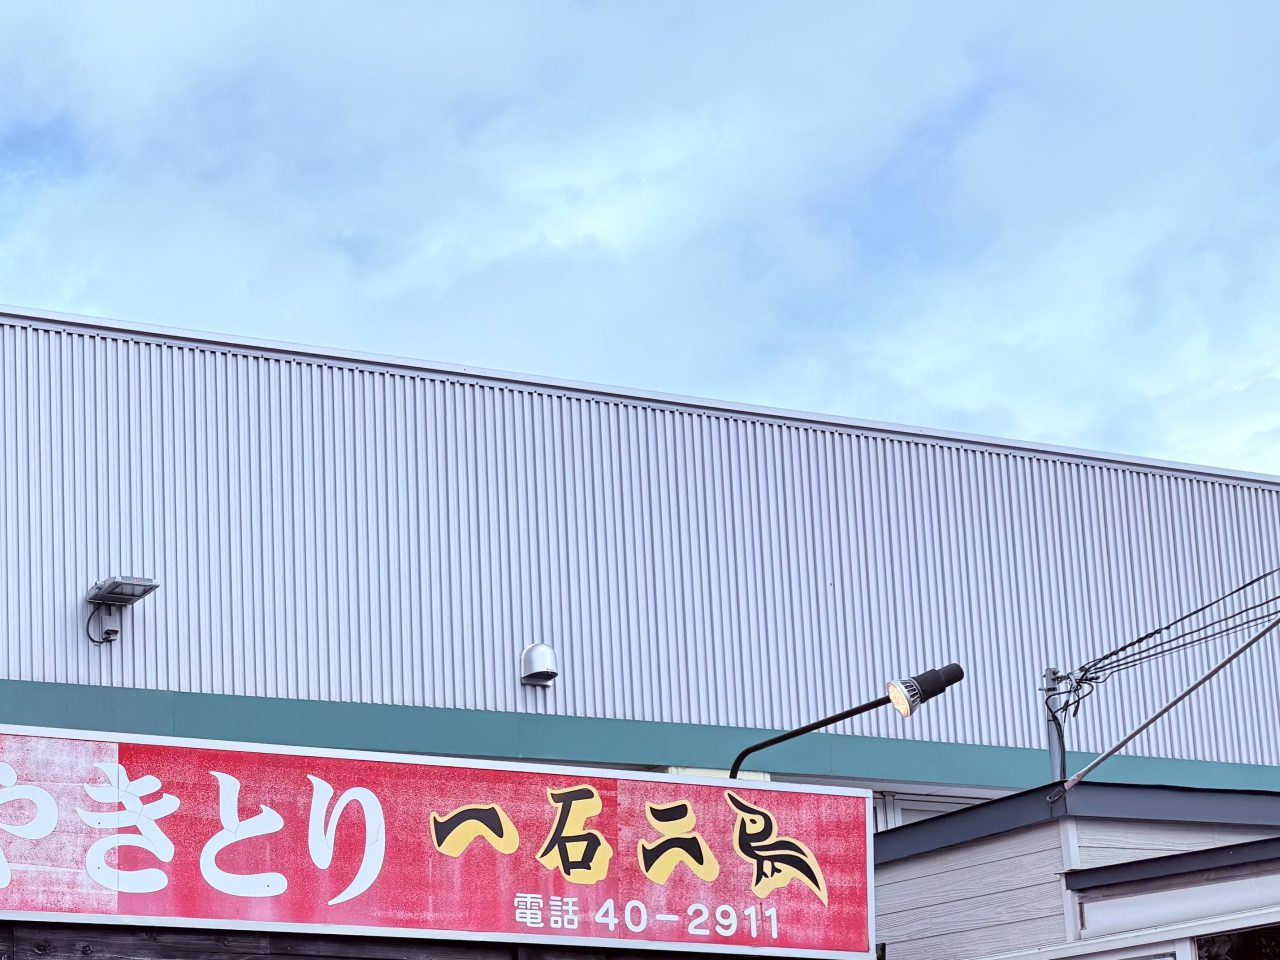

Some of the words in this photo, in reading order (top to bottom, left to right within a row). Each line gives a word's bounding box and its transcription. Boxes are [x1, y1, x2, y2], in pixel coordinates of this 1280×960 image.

[430, 784, 827, 906] 一石二鳥
[513, 893, 579, 930] 電話
[595, 904, 778, 940] 40-2911
